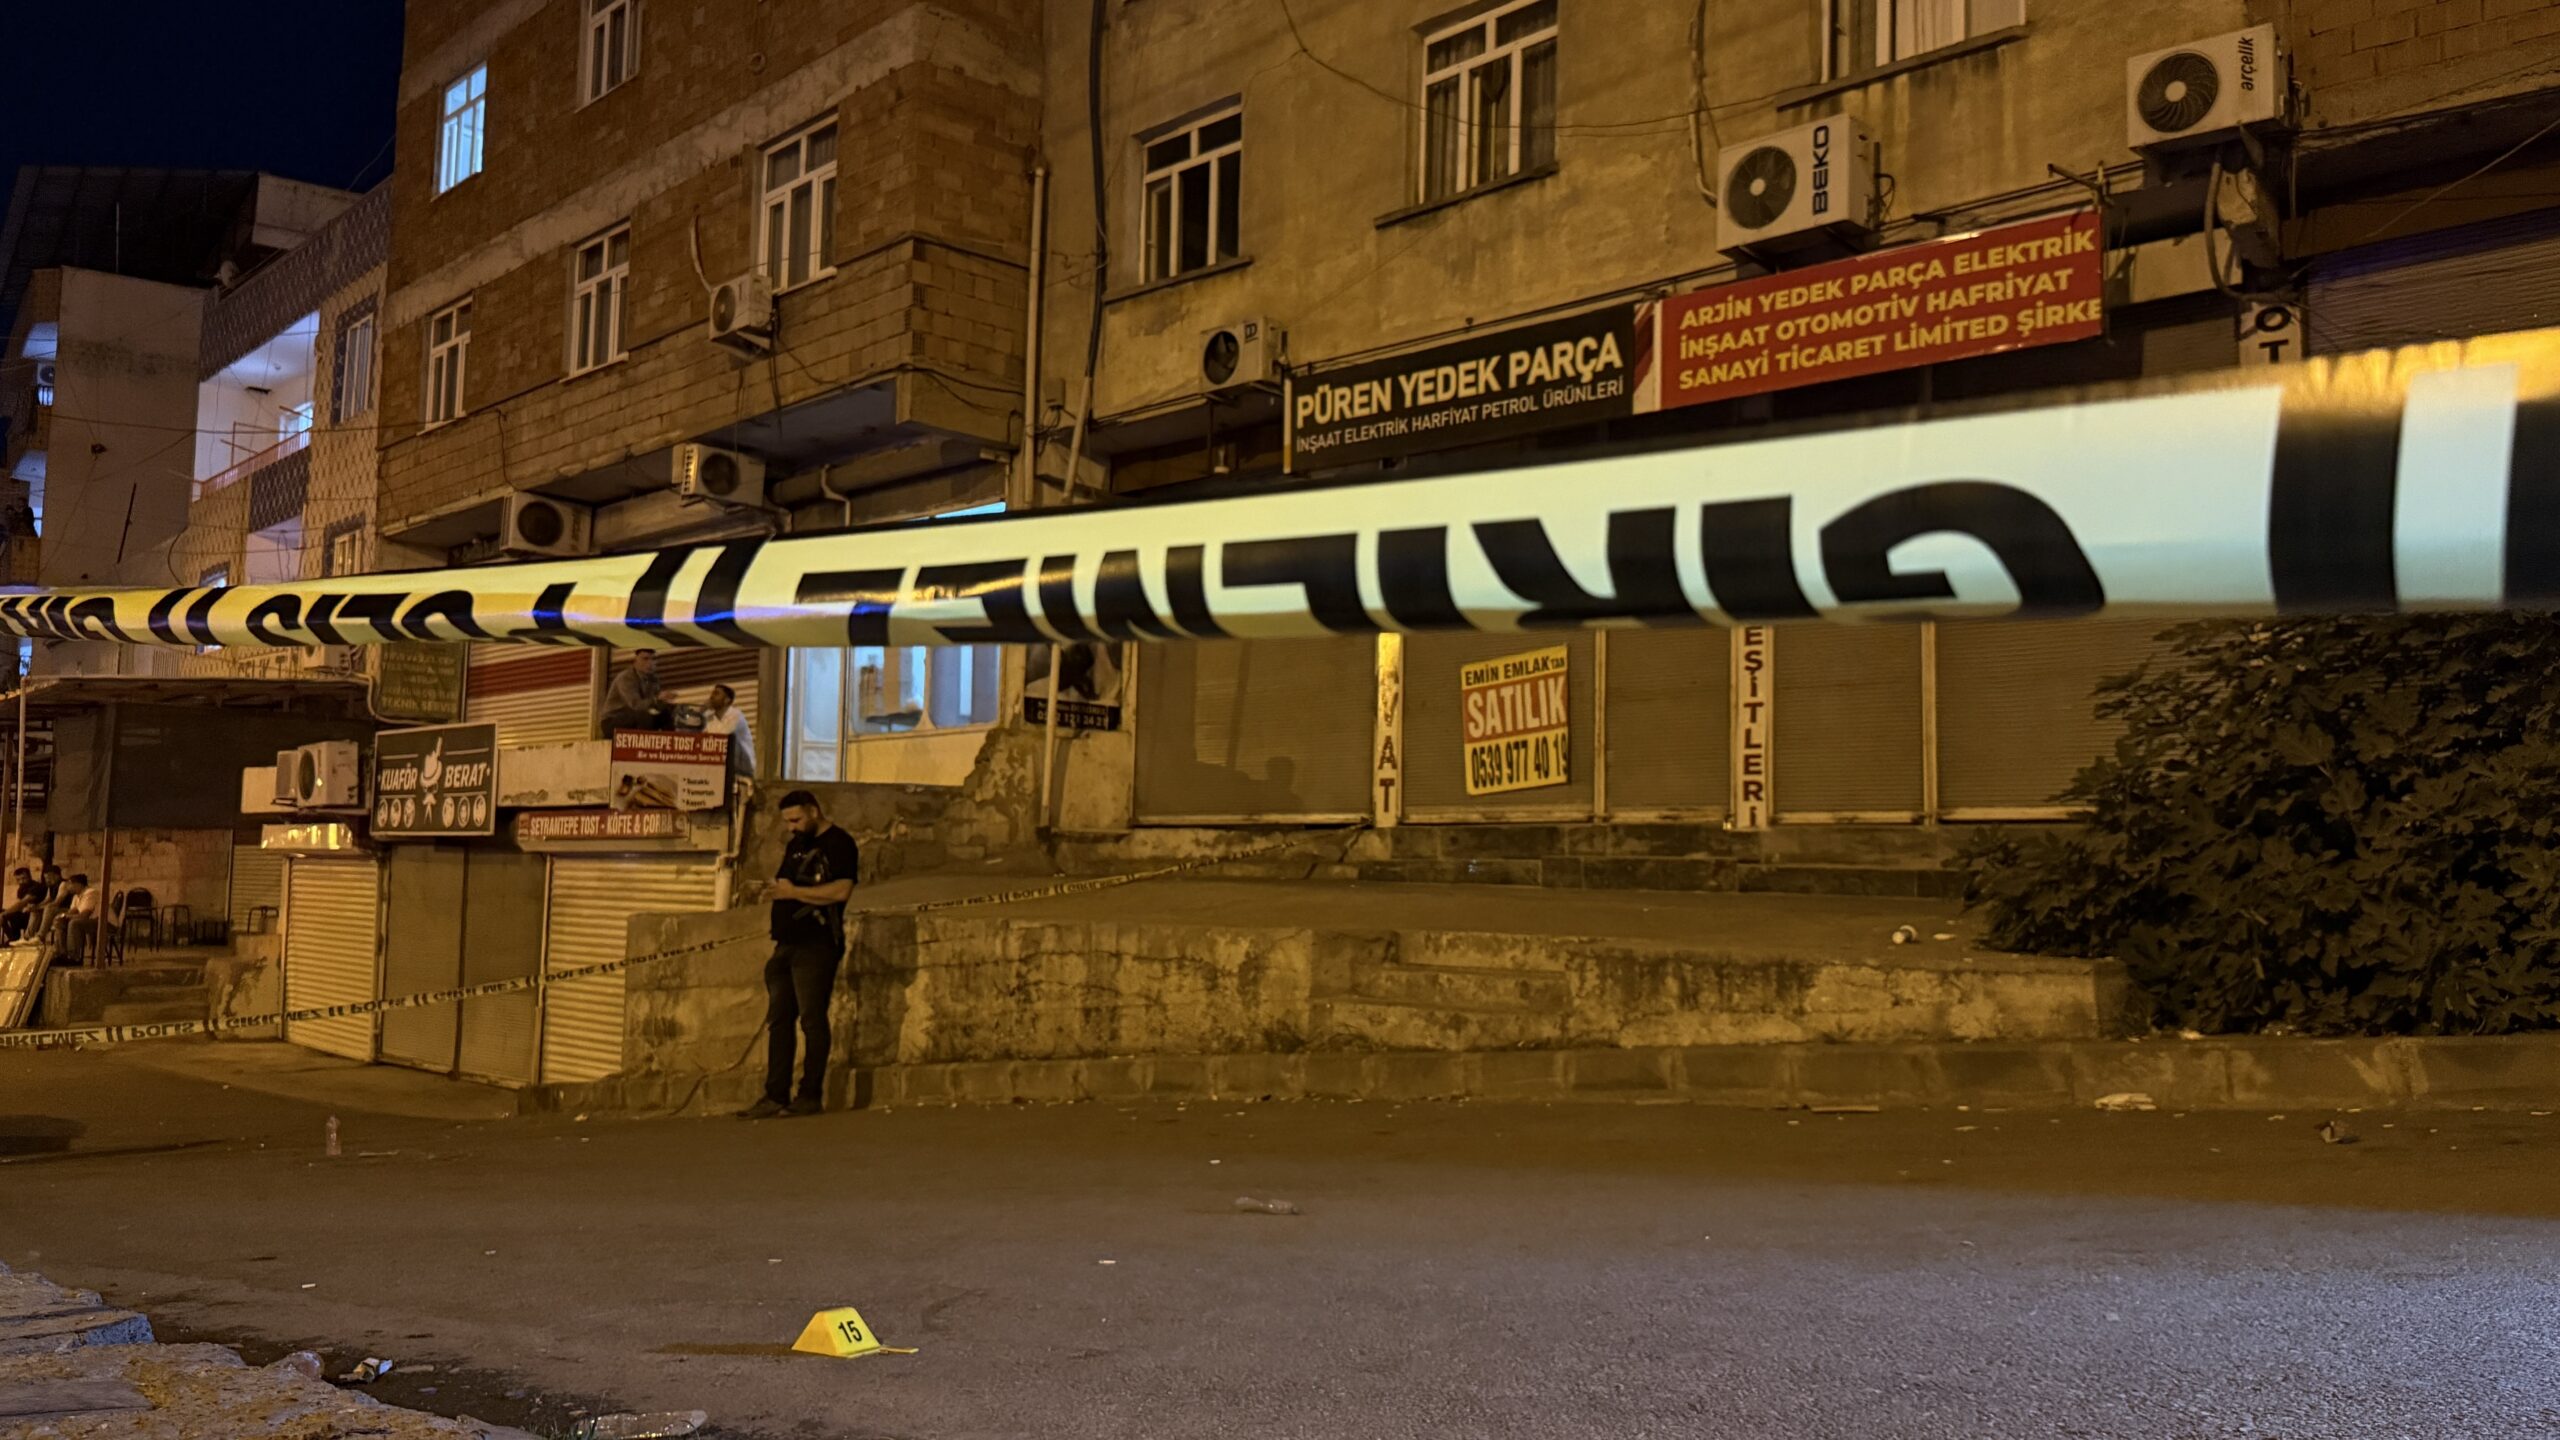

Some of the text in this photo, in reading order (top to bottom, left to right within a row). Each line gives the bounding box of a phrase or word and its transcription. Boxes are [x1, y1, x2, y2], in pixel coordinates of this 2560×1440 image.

[2238, 36, 2257, 91] arçelik
[1813, 125, 1829, 216] BEKO
[1679, 227, 2095, 330] ARJİN YEDEK PARÇA ELEKTRİK
[1680, 268, 2073, 360] İNŞAAT OTOMOTİV HAFRİYAT
[1679, 298, 2102, 390] SANAYİ TİCARET LİMİTED ŞİRKE
[1297, 332, 1624, 429] PÜREN YEDEK PARÇA
[1296, 375, 1624, 454] İNŞAAT ELEKTRİK HARFİYAT PETROL ÜRÜNLERİ
[1464, 664, 1500, 687] EMİN
[1467, 675, 1567, 739] SATILIK
[616, 733, 672, 751] SEYRANTEPE
[674, 736, 695, 751] TOST
[1471, 743, 1503, 789] 0539
[1505, 739, 1529, 784] 977
[1534, 735, 1549, 779] 40
[381, 762, 487, 791] KUAFÖR BERAT
[530, 816, 579, 836] SEYRANTEPE
[580, 815, 600, 835] TOST
[606, 812, 632, 834] KÖFTE
[838, 1320, 862, 1344] 15
